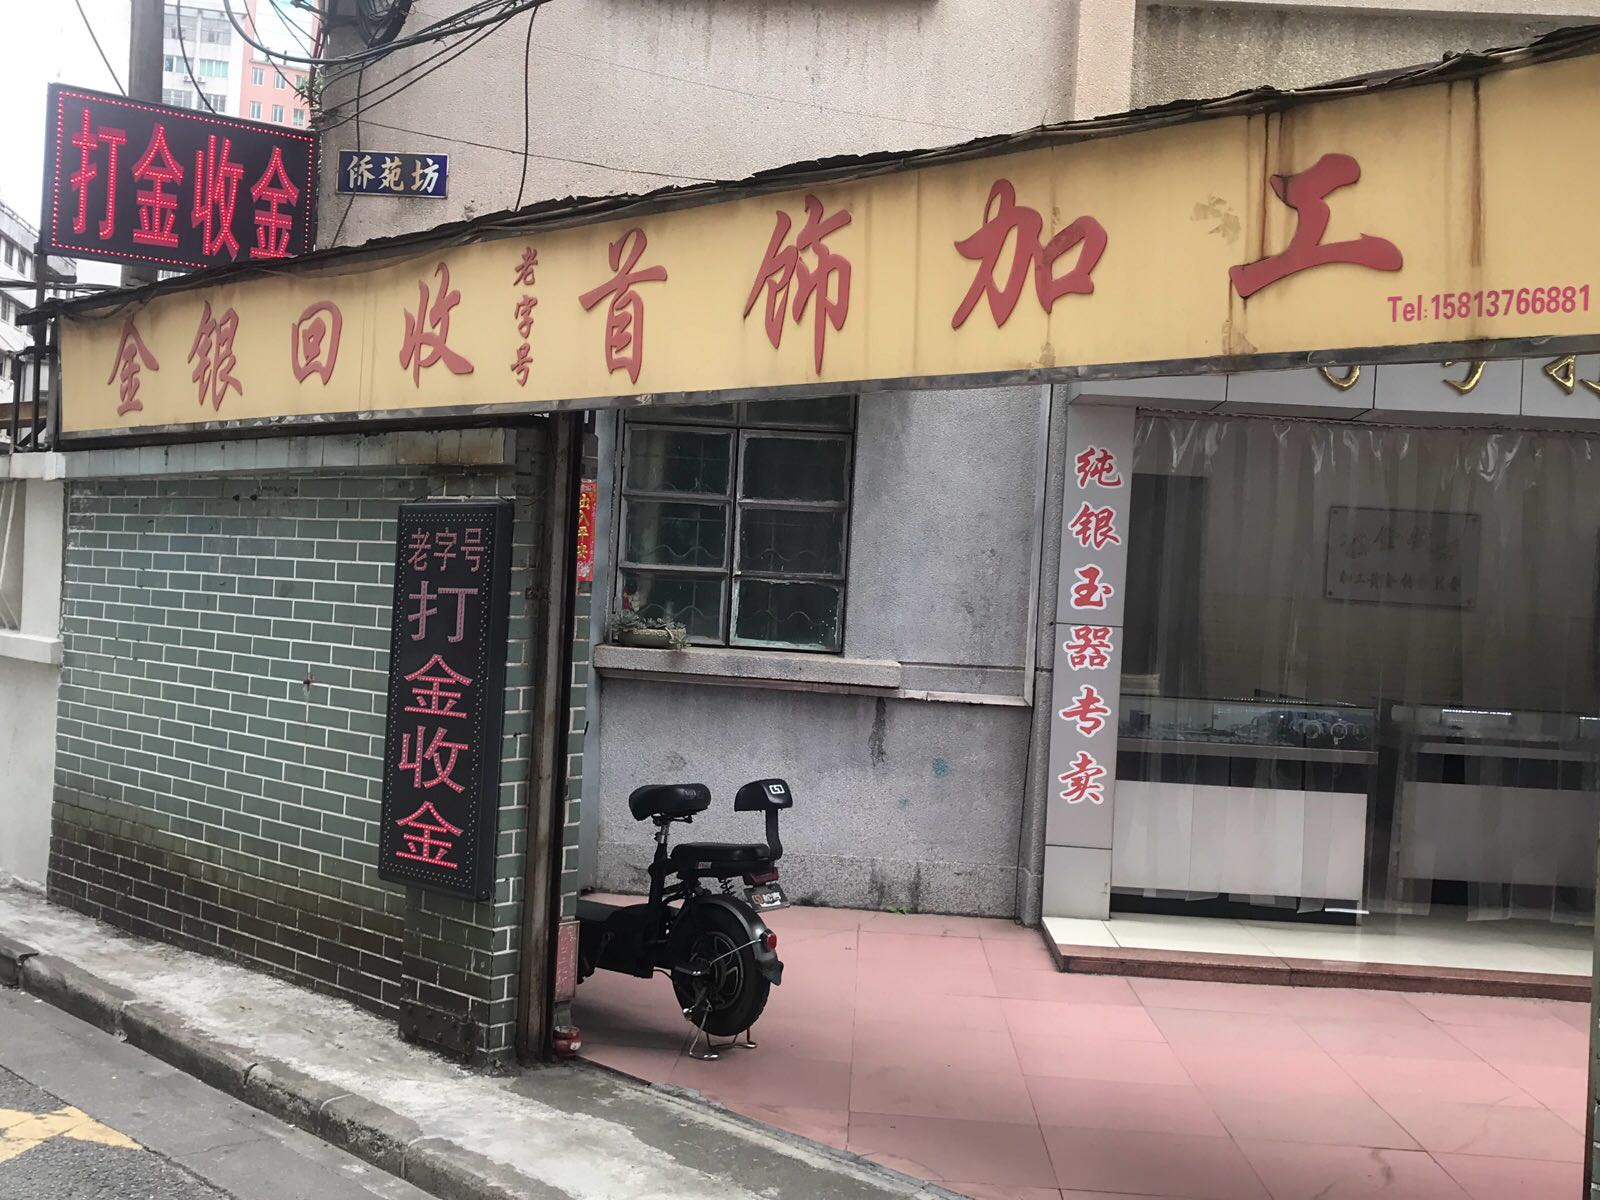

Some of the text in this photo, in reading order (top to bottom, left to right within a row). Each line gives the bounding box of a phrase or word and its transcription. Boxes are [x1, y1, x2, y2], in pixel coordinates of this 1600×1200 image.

[69, 106, 300, 259] 打金收金
[346, 154, 440, 193] 侨苑坊
[107, 262, 474, 416] 金银回收
[510, 246, 539, 387] 老字号
[579, 153, 1403, 375] 首饰加工
[407, 527, 485, 573] 老字号
[1060, 446, 1123, 803] 纯银玉器专卖
[395, 580, 479, 870] 打金收金
